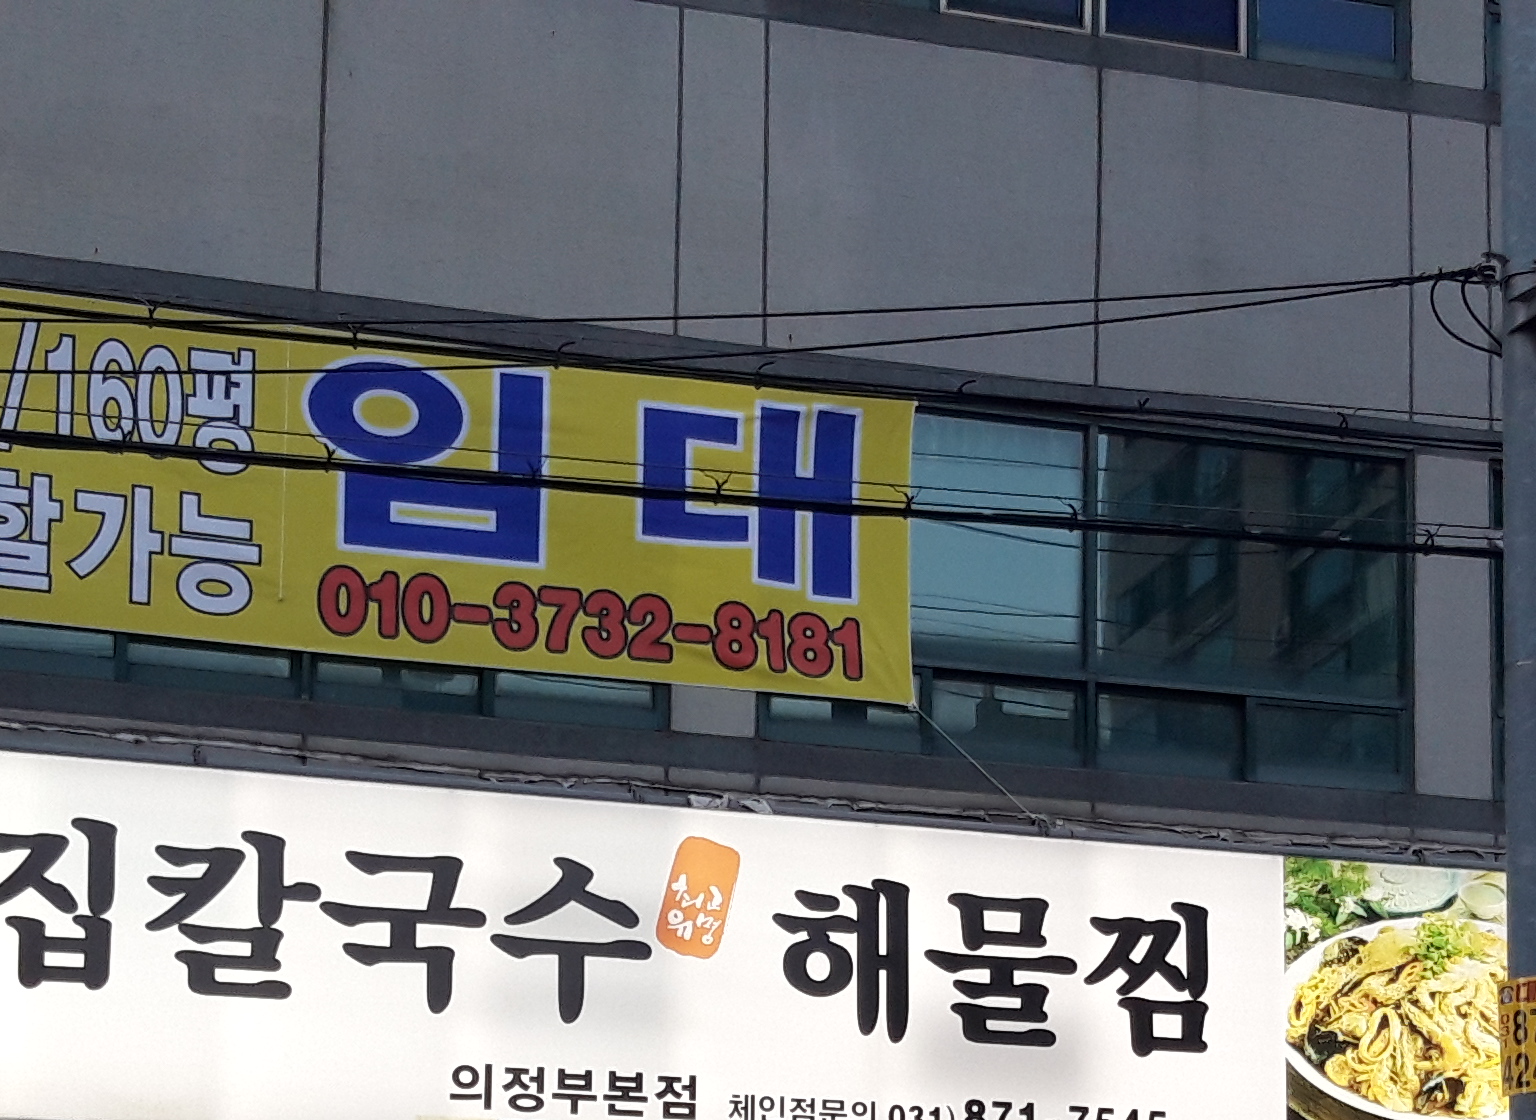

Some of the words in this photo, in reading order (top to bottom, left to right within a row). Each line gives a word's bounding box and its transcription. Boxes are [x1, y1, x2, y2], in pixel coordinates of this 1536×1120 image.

[317, 566, 864, 682] 010-3732-8181
[771, 877, 1212, 1058] 해물찜
[449, 1062, 699, 1120] 의정부본점
